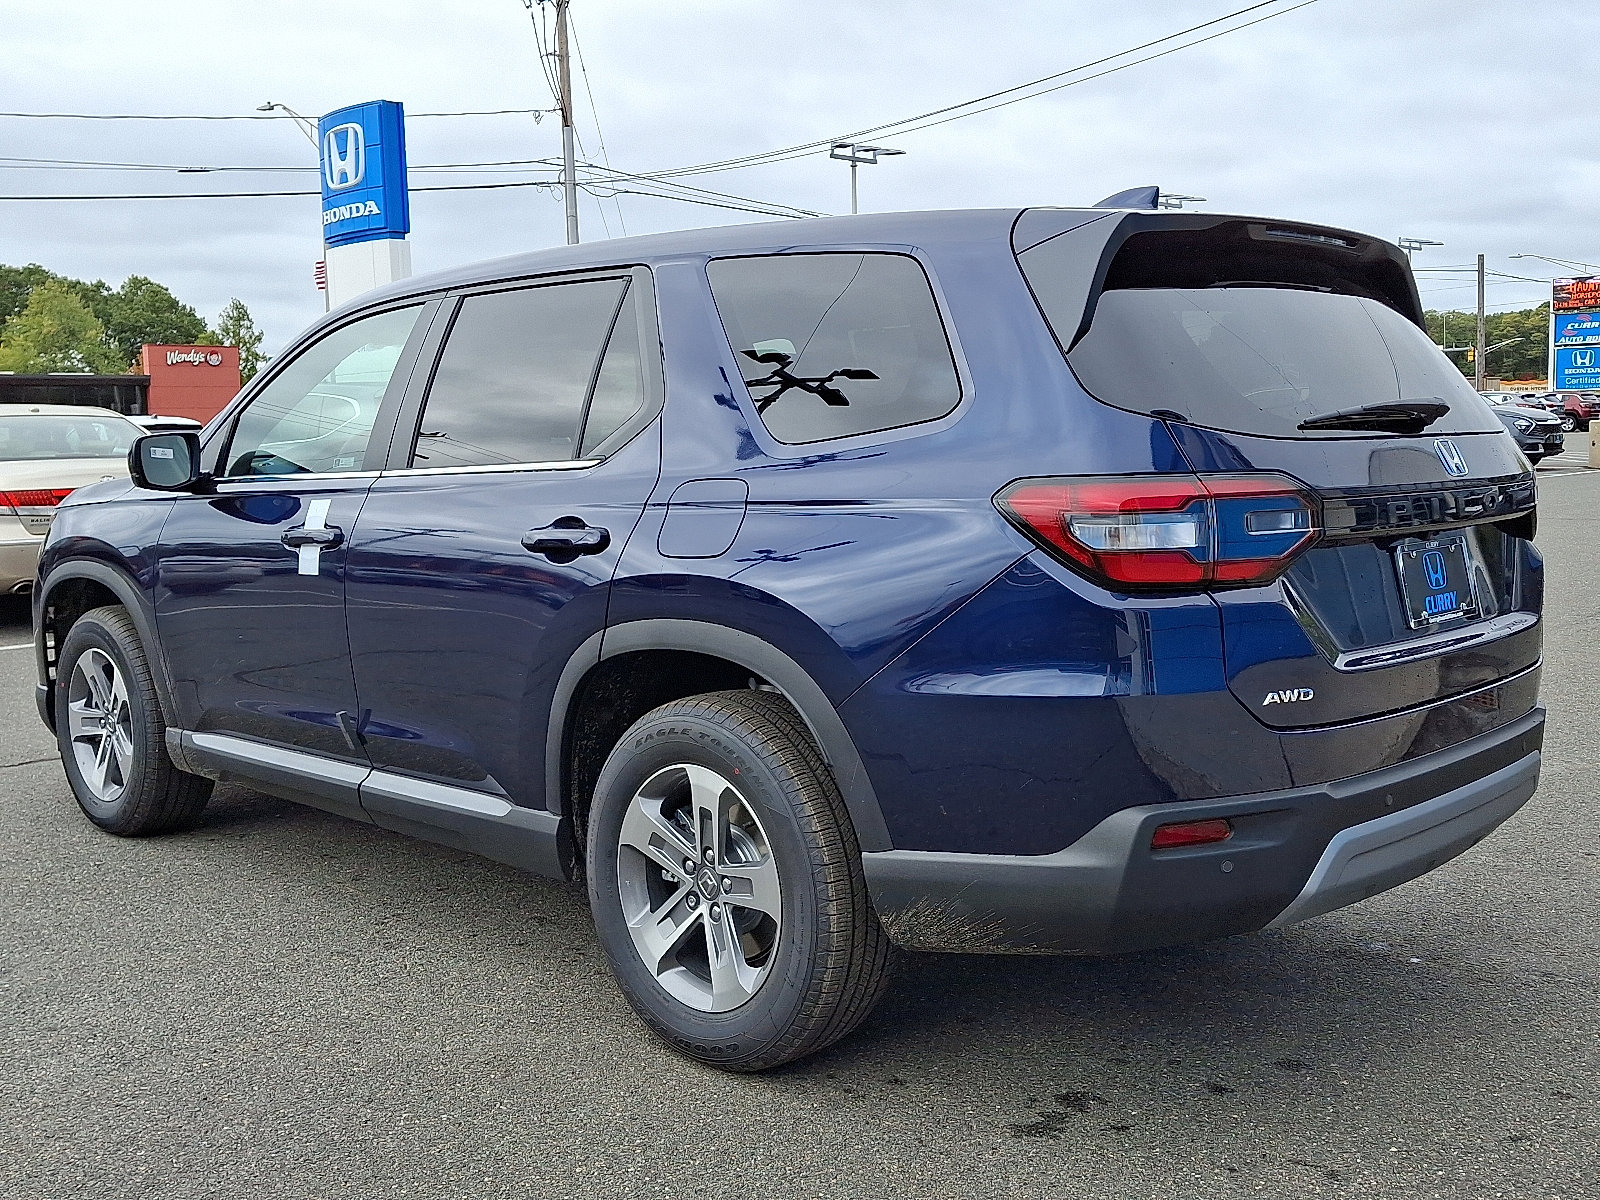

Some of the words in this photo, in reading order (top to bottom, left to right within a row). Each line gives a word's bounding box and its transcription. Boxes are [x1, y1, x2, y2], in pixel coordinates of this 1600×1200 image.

[322, 201, 381, 226] HONDA
[166, 348, 206, 366] Wendy's
[1425, 590, 1457, 614] CURRY
[1262, 687, 1314, 706] AWD
[633, 726, 692, 750] EAGLE
